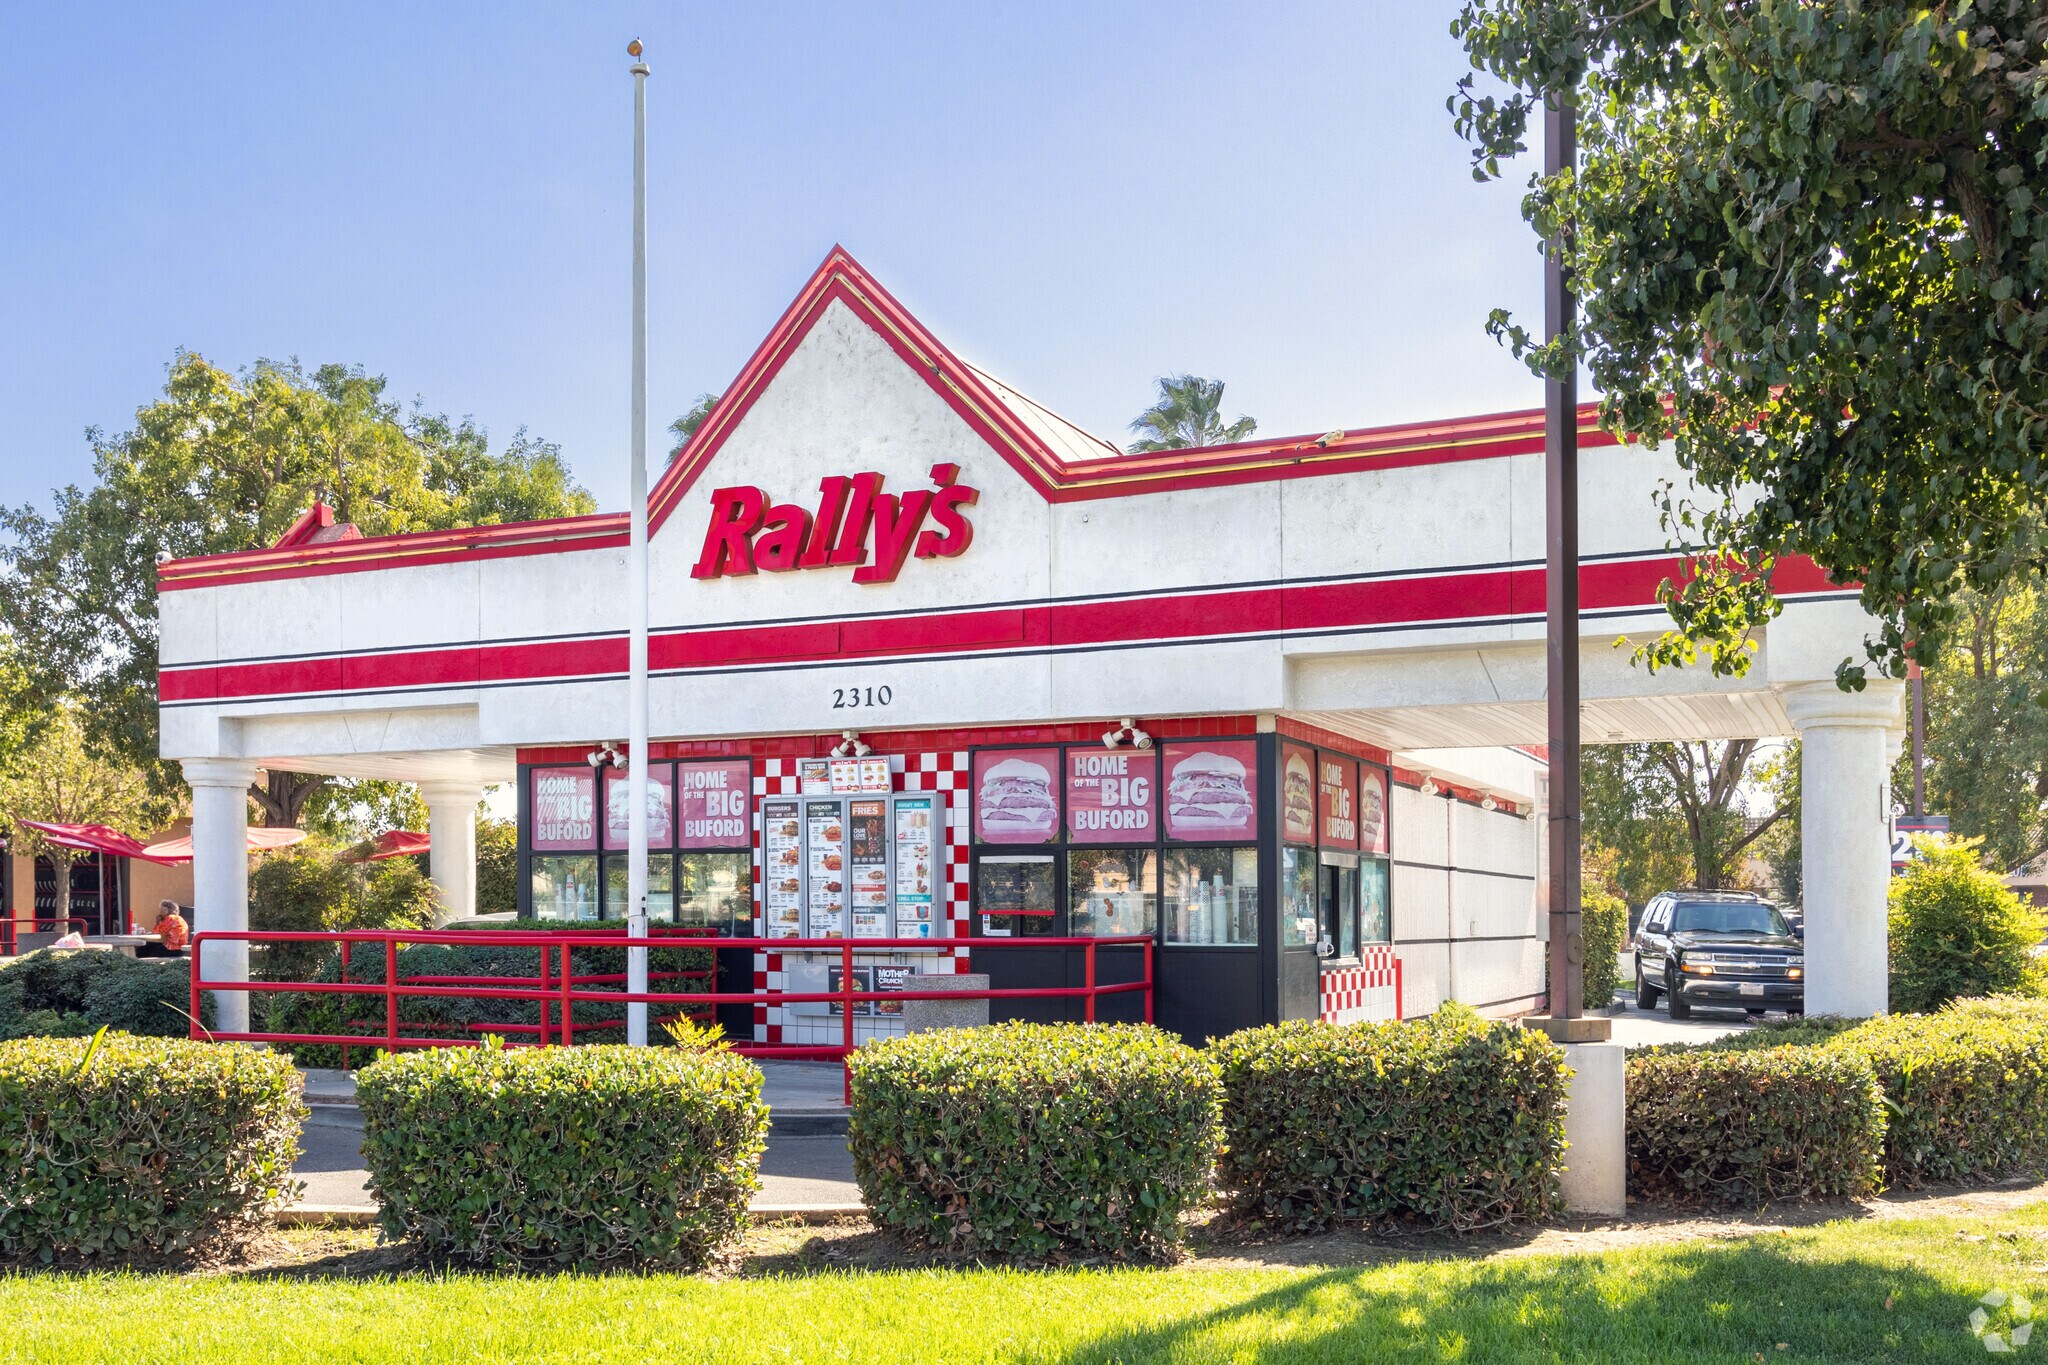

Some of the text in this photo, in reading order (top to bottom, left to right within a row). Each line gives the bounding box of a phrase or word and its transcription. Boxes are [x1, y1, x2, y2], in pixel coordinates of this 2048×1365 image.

[690, 463, 980, 585] Rally's
[832, 685, 892, 709] 2310
[1075, 756, 1128, 776] HOME
[1321, 762, 1342, 786] HOME
[537, 777, 576, 794] HOME
[684, 770, 727, 790] HOME
[1074, 777, 1149, 806] OF THE BIG
[558, 795, 592, 820] BIG
[706, 790, 744, 816] BIG
[852, 806, 878, 815] FRIES
[1332, 786, 1350, 819] BIG
[537, 823, 592, 841] BUFORD
[685, 818, 744, 838] BUFORD
[1075, 810, 1149, 830] BUFORD
[1327, 816, 1354, 840] BUFORD
[1892, 830, 1912, 861] 2
[878, 969, 909, 978] MOTHER
